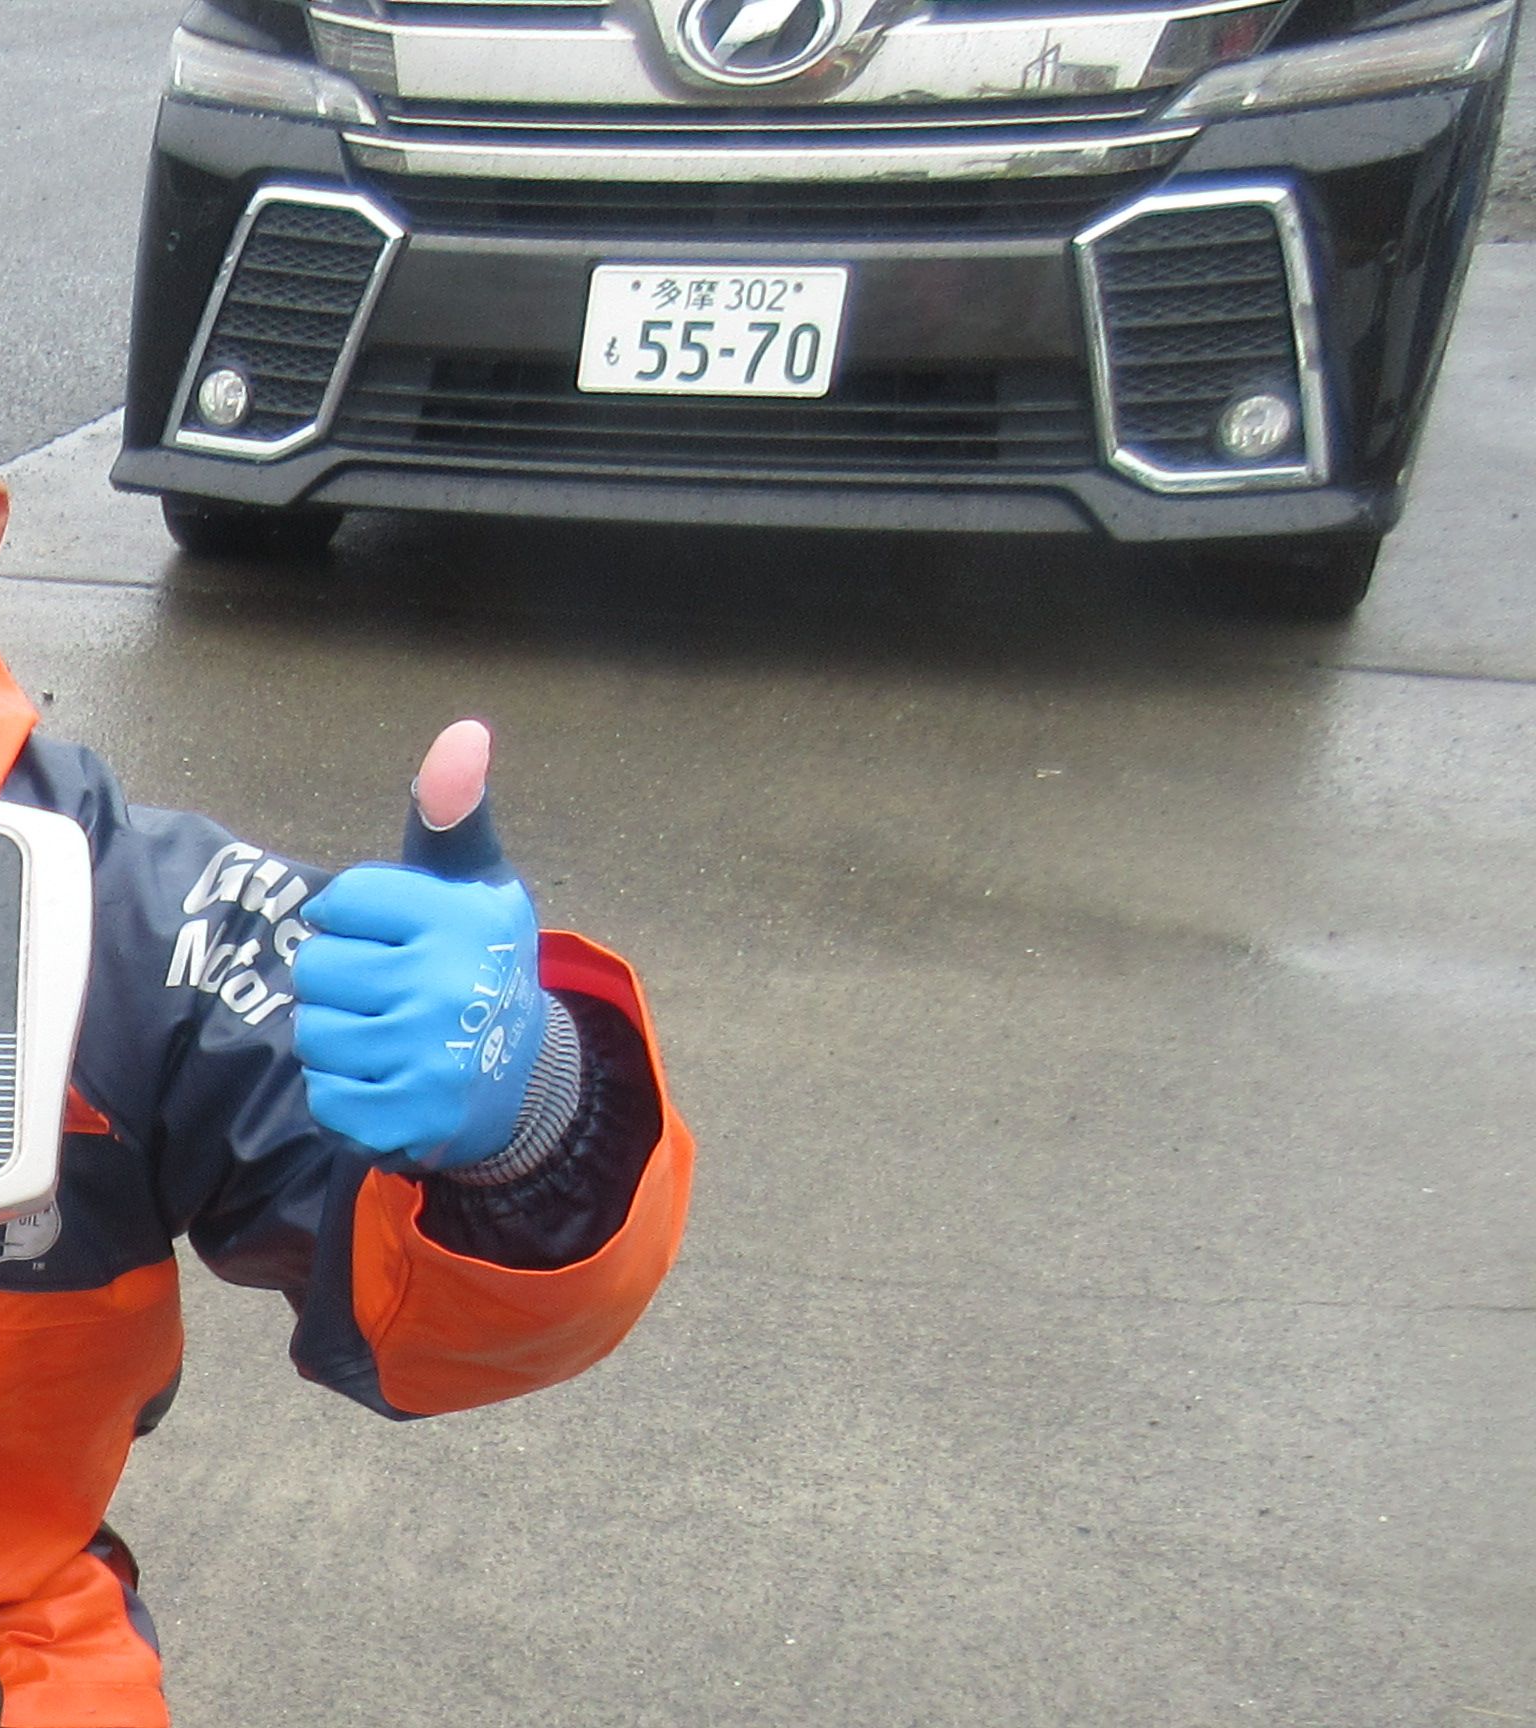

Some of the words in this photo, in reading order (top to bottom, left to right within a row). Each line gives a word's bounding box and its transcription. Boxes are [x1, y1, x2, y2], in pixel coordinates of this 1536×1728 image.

[651, 278, 719, 311] 多摩
[725, 279, 788, 312] 302
[604, 336, 620, 366] も
[634, 320, 821, 384] 55-70
[183, 842, 312, 967] Gua
